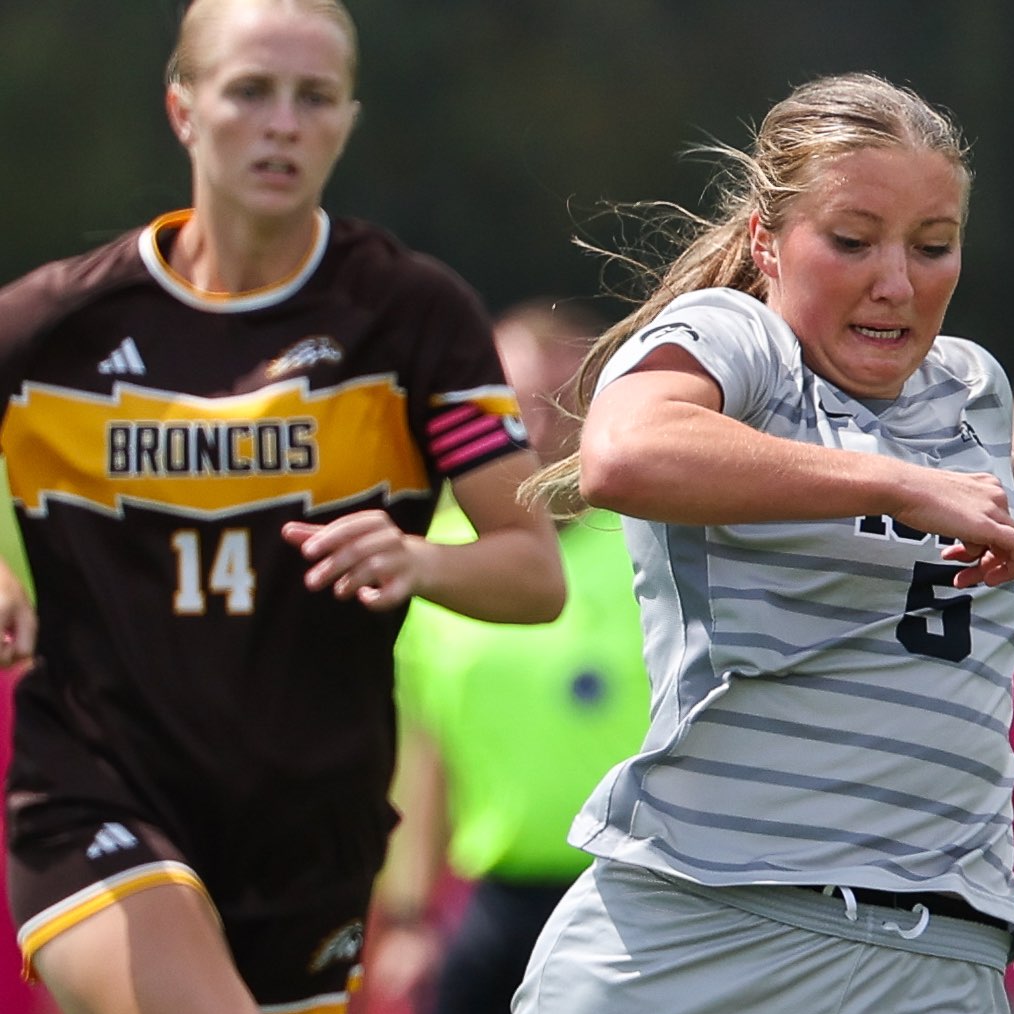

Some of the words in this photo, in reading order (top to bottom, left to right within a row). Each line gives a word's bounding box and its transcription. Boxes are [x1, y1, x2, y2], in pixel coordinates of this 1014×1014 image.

[107, 419, 317, 477] BRONCOS
[172, 528, 255, 615] 14
[896, 561, 979, 663] 5
